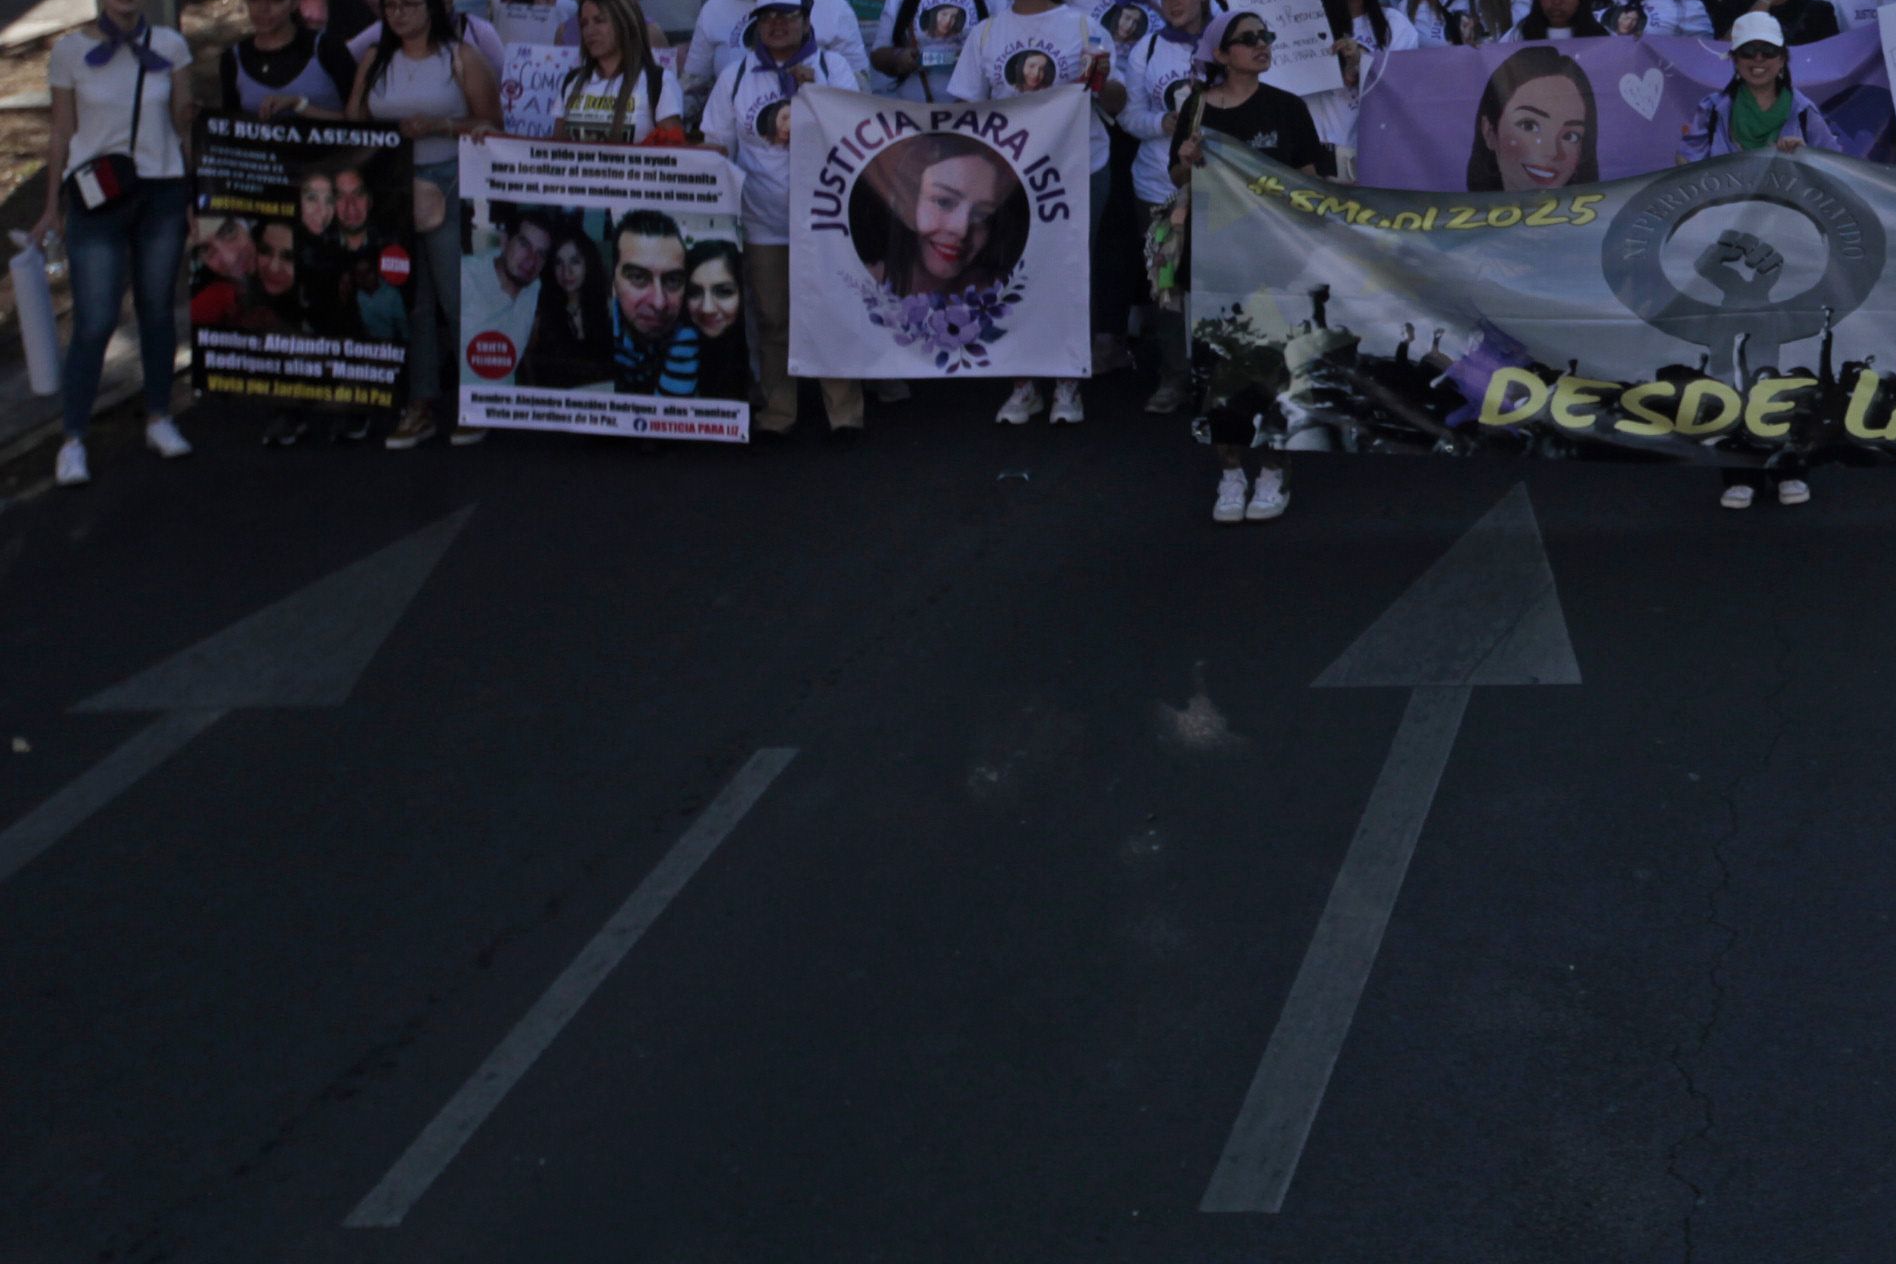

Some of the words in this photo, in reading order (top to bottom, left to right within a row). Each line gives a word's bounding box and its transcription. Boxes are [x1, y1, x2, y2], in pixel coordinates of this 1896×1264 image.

[207, 117, 229, 137] SE
[234, 121, 302, 144] BUSCA
[306, 127, 402, 149] ASESINO
[530, 146, 549, 159] Les
[551, 148, 576, 163] pido
[577, 150, 596, 163] por
[598, 150, 626, 163] favor
[628, 152, 642, 164] su
[643, 153, 678, 168] ayuda
[491, 162, 516, 176] para
[518, 161, 567, 177] localizar
[581, 167, 625, 179] asesino
[627, 168, 641, 180] de
[643, 170, 658, 182] mi
[659, 169, 718, 186] hermanita
[808, 110, 924, 236] JUSTICIA
[930, 109, 1031, 165] PARA
[1028, 153, 1072, 225] ISIS
[508, 181, 524, 193] por
[542, 183, 566, 196] para
[567, 185, 587, 198] que
[588, 185, 629, 198] mañana
[630, 188, 642, 199] no
[644, 188, 663, 200] sea
[664, 189, 675, 201] ni
[676, 190, 695, 202] una
[264, 333, 341, 358] Alejandro
[283, 358, 324, 378] alias
[244, 379, 271, 397] por
[272, 379, 333, 401] Jardines
[333, 384, 351, 402] de
[353, 386, 369, 403] la
[369, 387, 394, 407] Paz
[514, 393, 563, 411] Alejandro
[1478, 366, 1820, 440] DESDE
[512, 410, 530, 423] por
[531, 409, 573, 425] Jardines
[574, 413, 588, 425] de
[588, 414, 599, 426] la
[650, 419, 696, 435] JUSTICIA
[698, 422, 726, 436] PARA
[726, 424, 740, 437] LIZ
